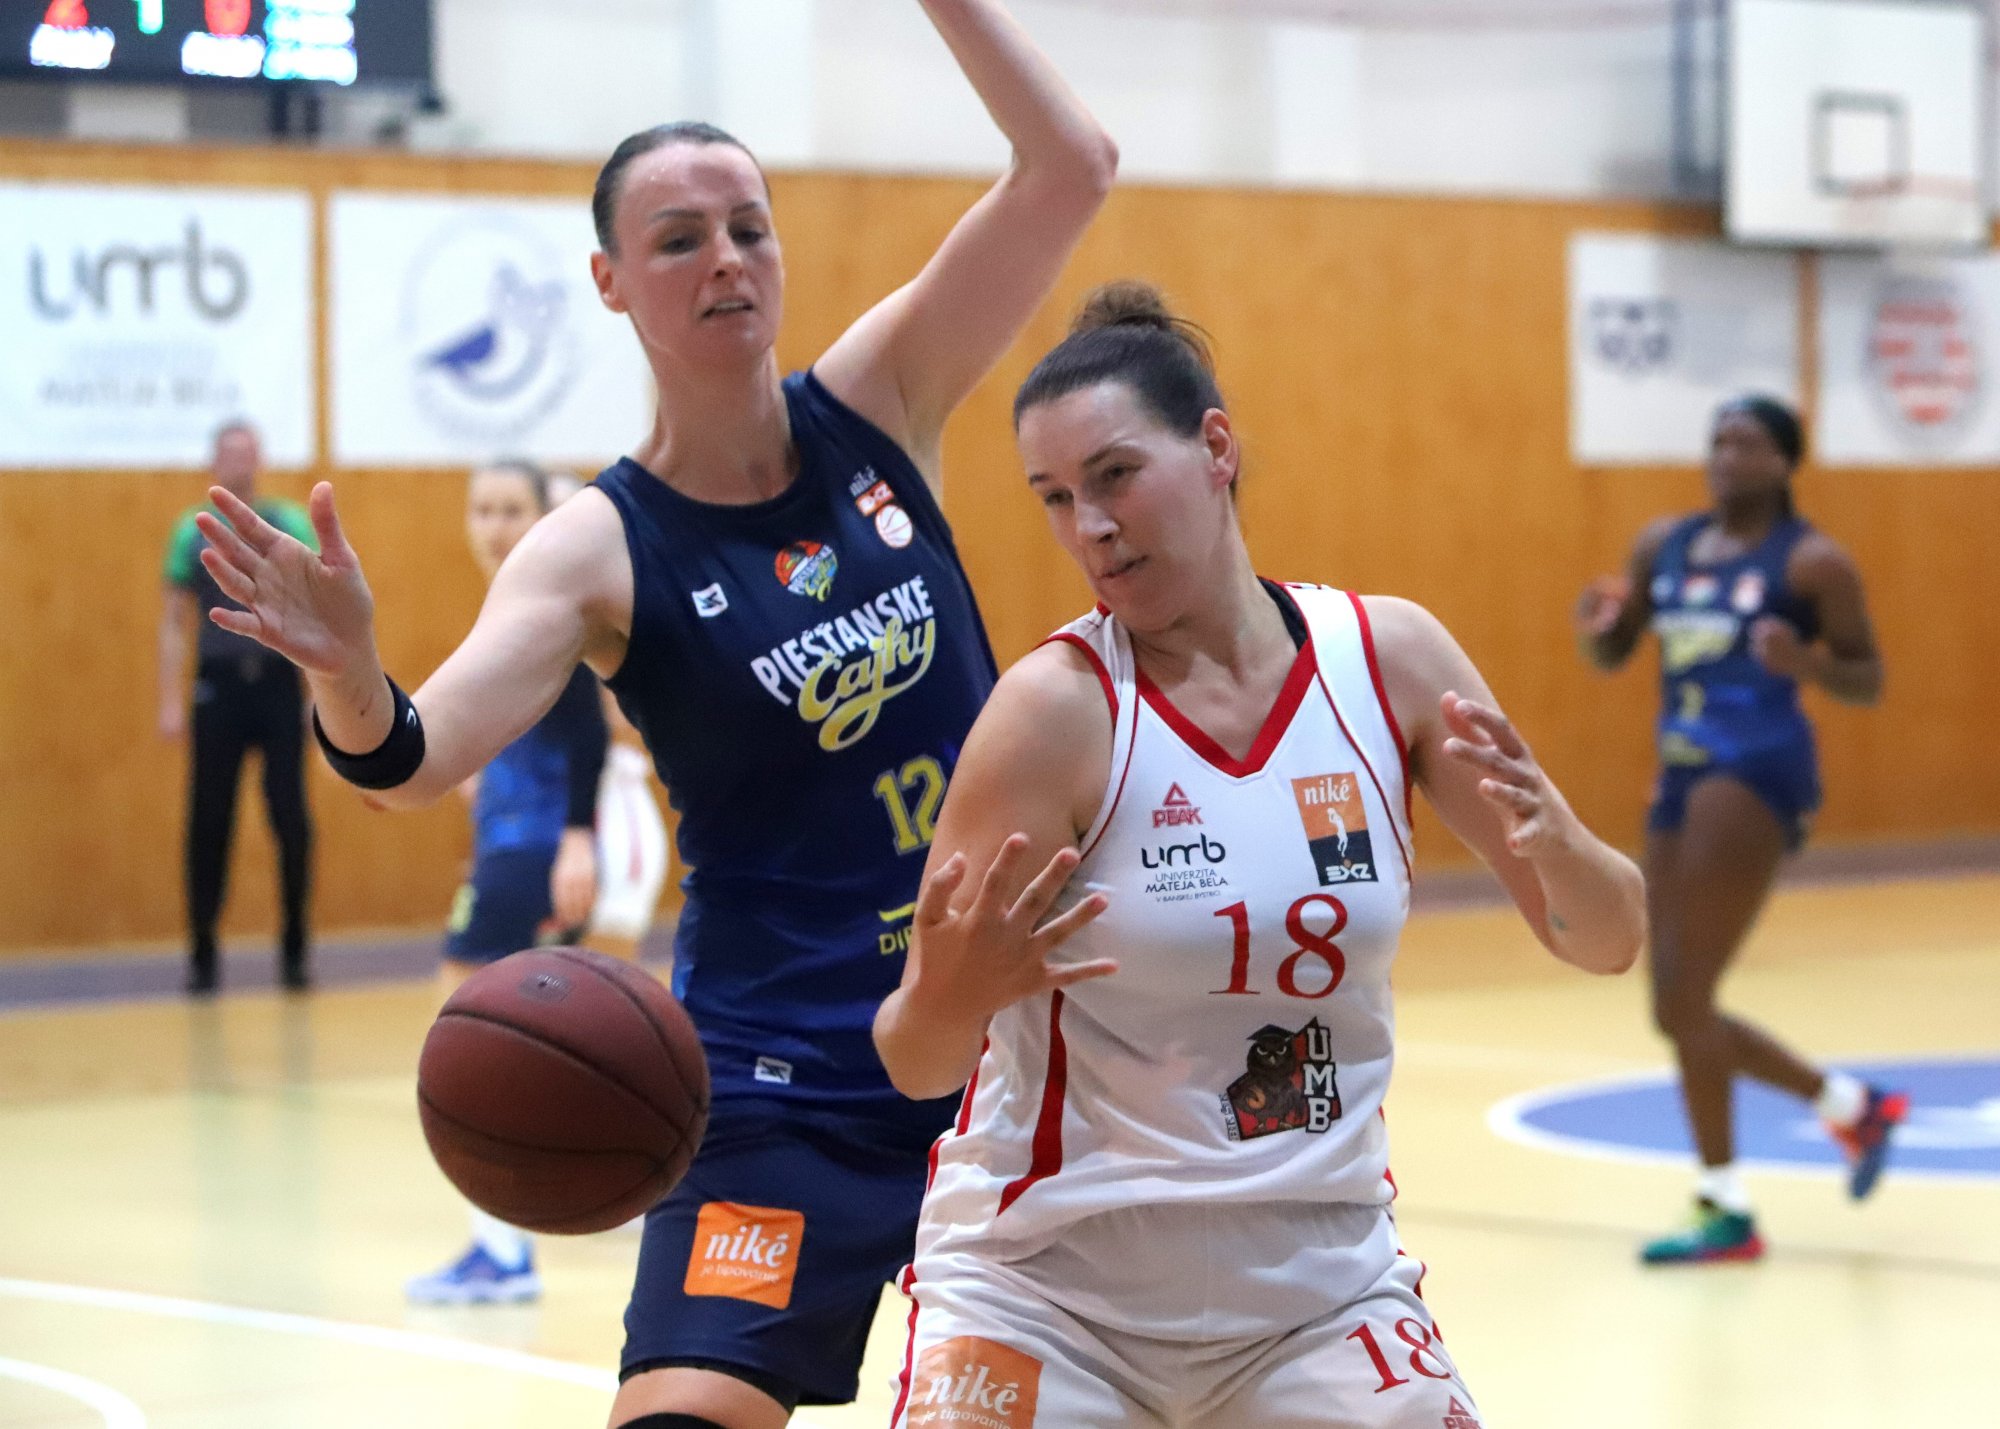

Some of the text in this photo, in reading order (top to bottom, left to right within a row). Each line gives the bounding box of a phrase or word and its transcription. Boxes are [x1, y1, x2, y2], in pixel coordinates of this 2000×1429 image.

[27, 218, 249, 322] umb
[873, 754, 947, 855] 12
[1303, 776, 1351, 805] niké
[1152, 807, 1203, 829] PEAK
[1141, 832, 1226, 869] umb
[1145, 876, 1229, 893] MATEJA BELA
[1155, 868, 1217, 882] UNIVERZITA
[1208, 893, 1348, 999] 18
[704, 1223, 789, 1268] niké
[1345, 1317, 1452, 1395] 18
[923, 1363, 1019, 1415] niké
